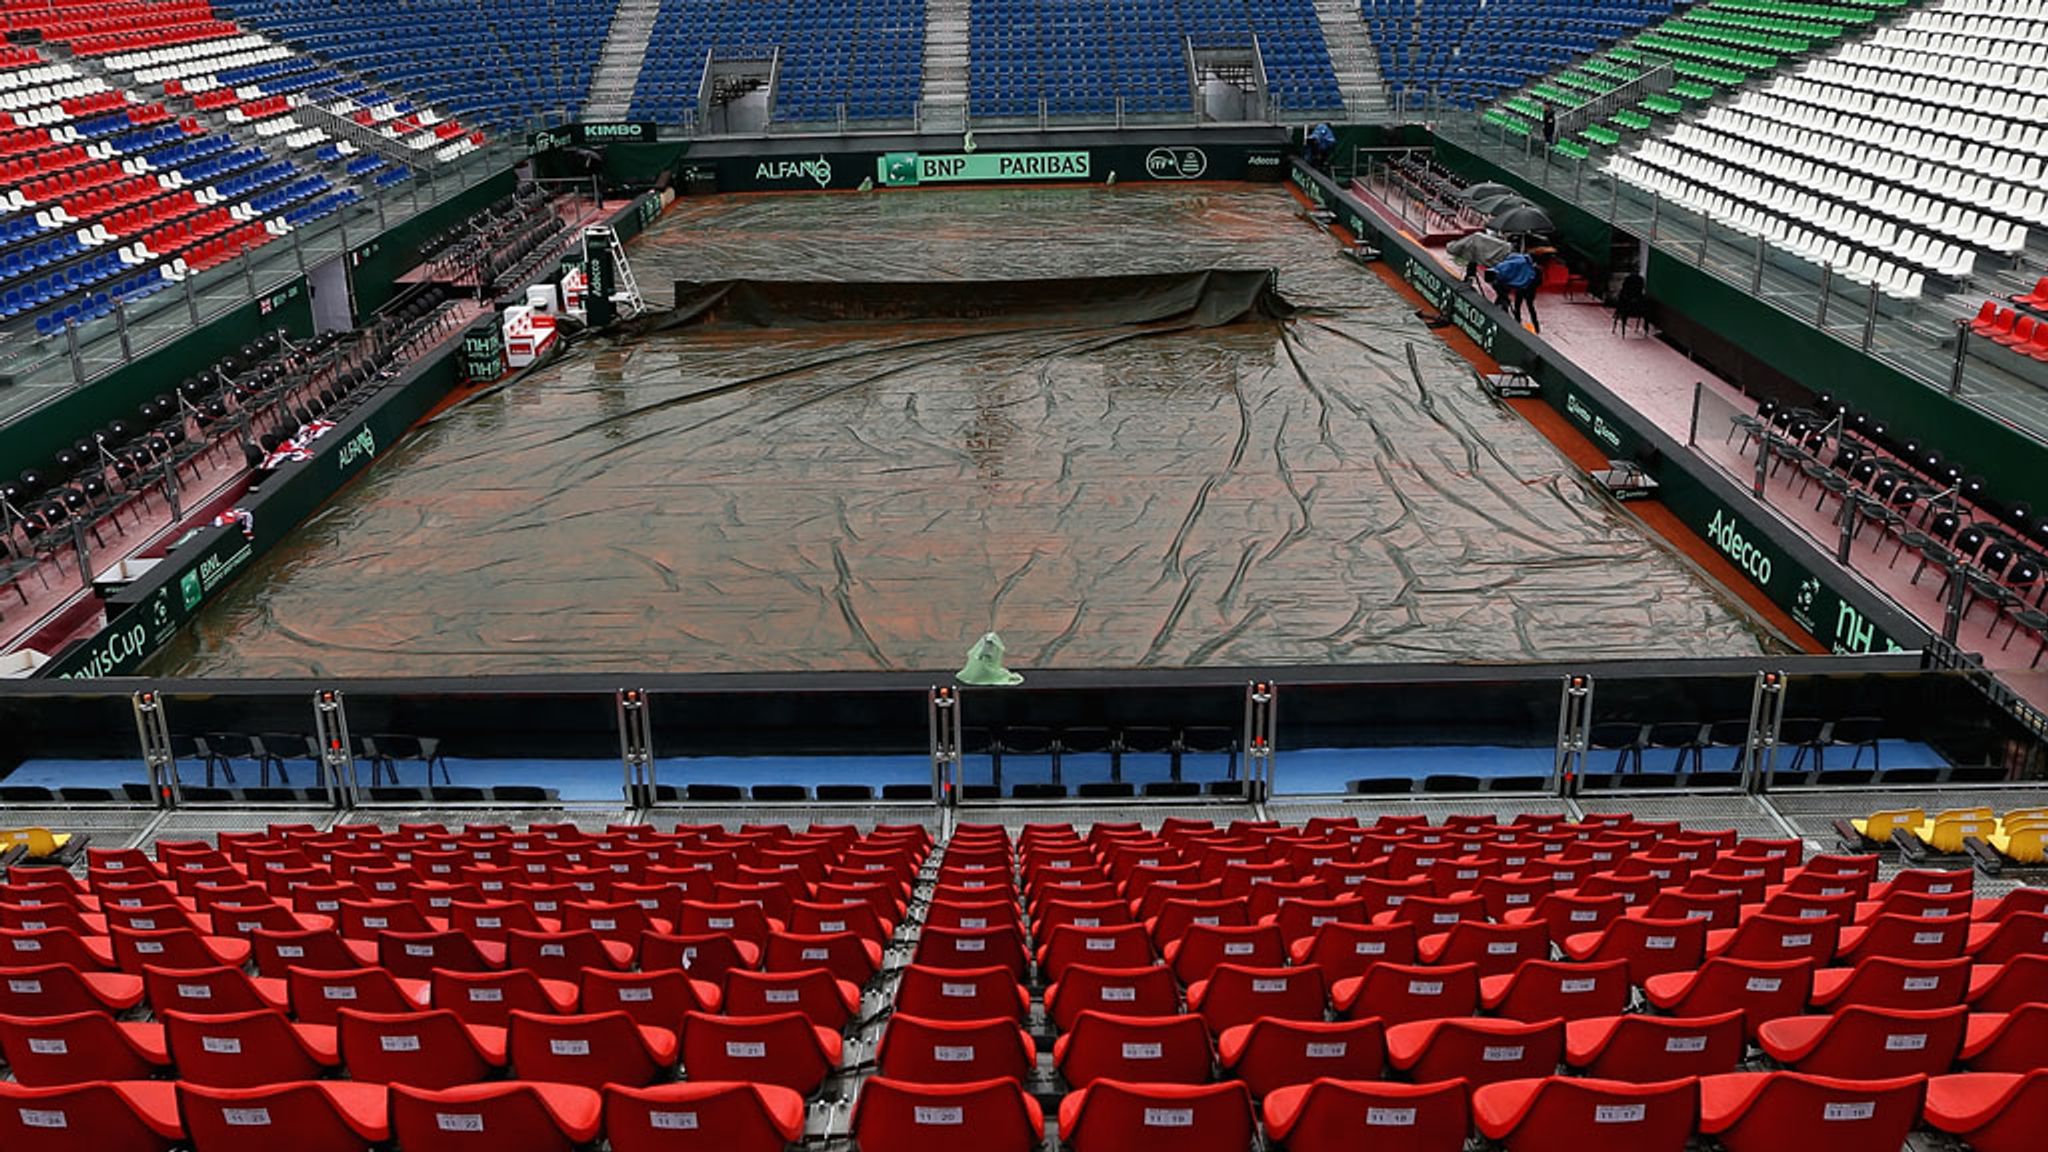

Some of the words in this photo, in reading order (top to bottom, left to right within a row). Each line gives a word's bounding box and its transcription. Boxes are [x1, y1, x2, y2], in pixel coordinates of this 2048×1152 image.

[584, 124, 642, 137] KIMBO
[924, 159, 966, 177] BNP
[1000, 155, 1088, 175] PARIBAS
[1707, 509, 1772, 585] Adecco
[200, 553, 222, 580] BNL
